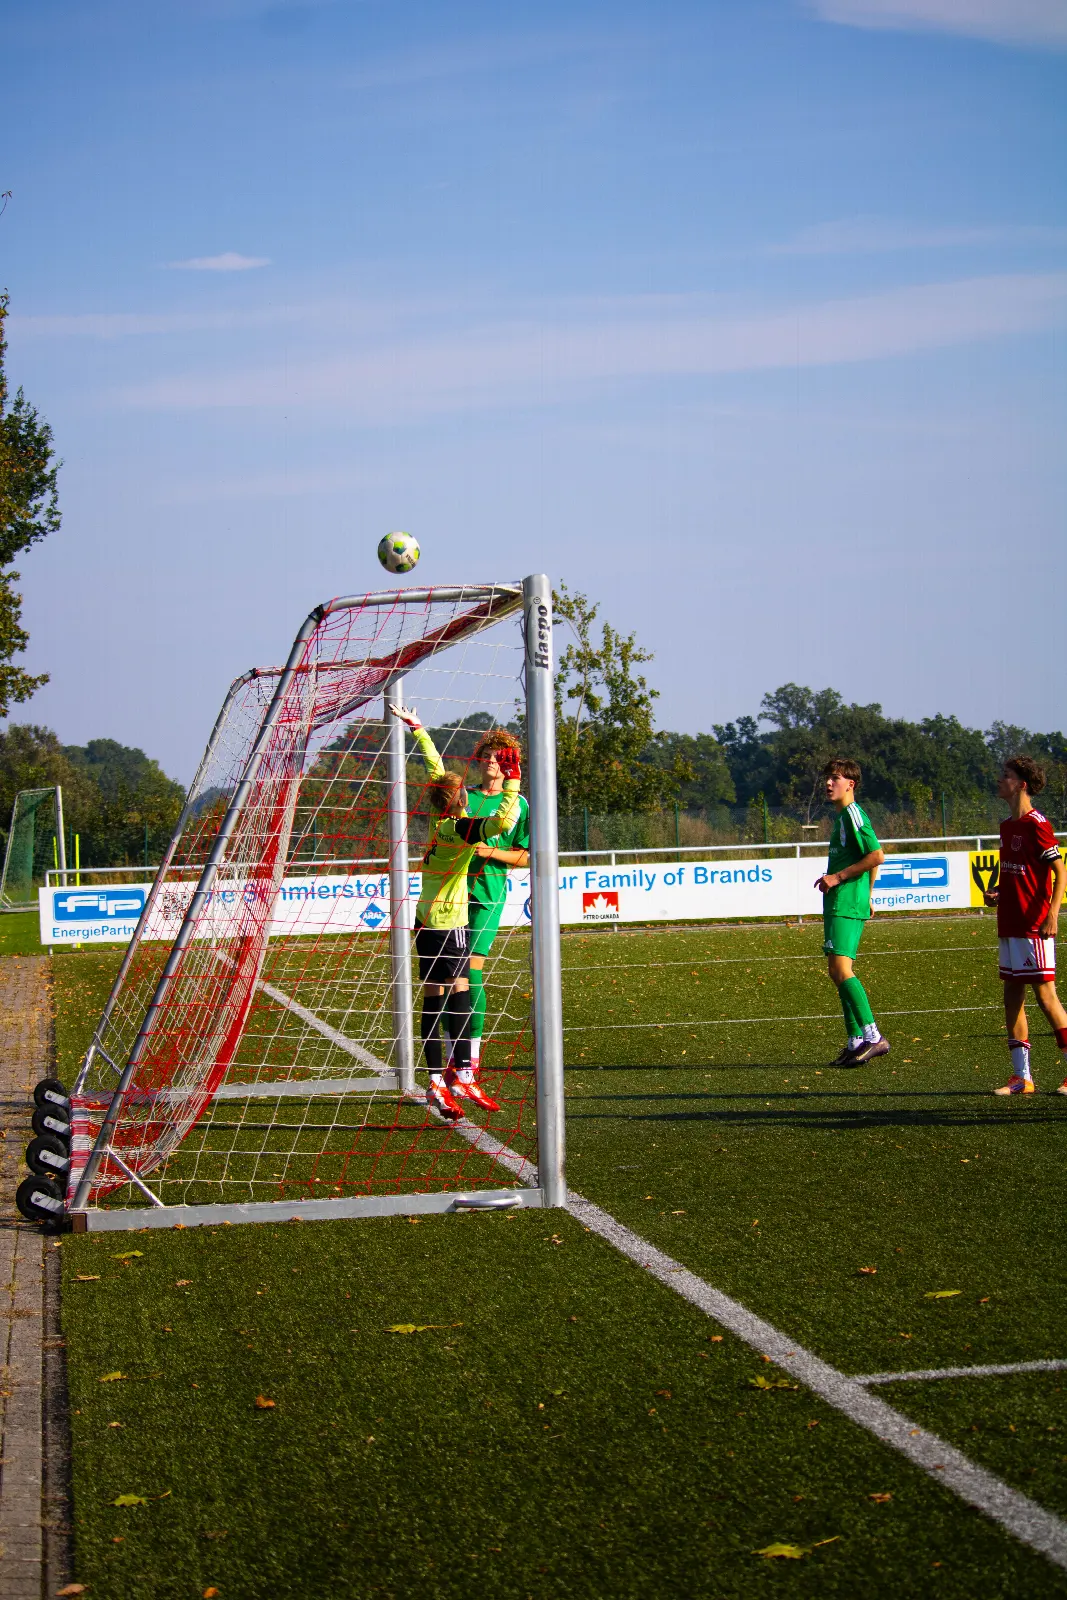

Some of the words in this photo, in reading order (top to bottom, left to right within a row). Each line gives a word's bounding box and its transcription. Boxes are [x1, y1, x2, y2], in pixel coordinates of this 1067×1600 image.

[558, 876, 578, 890] ur
[585, 869, 656, 891] Family
[663, 867, 685, 886] of
[694, 864, 773, 885] Brands
[870, 892, 952, 907] nergiePartner
[363, 911, 386, 921] ARAL
